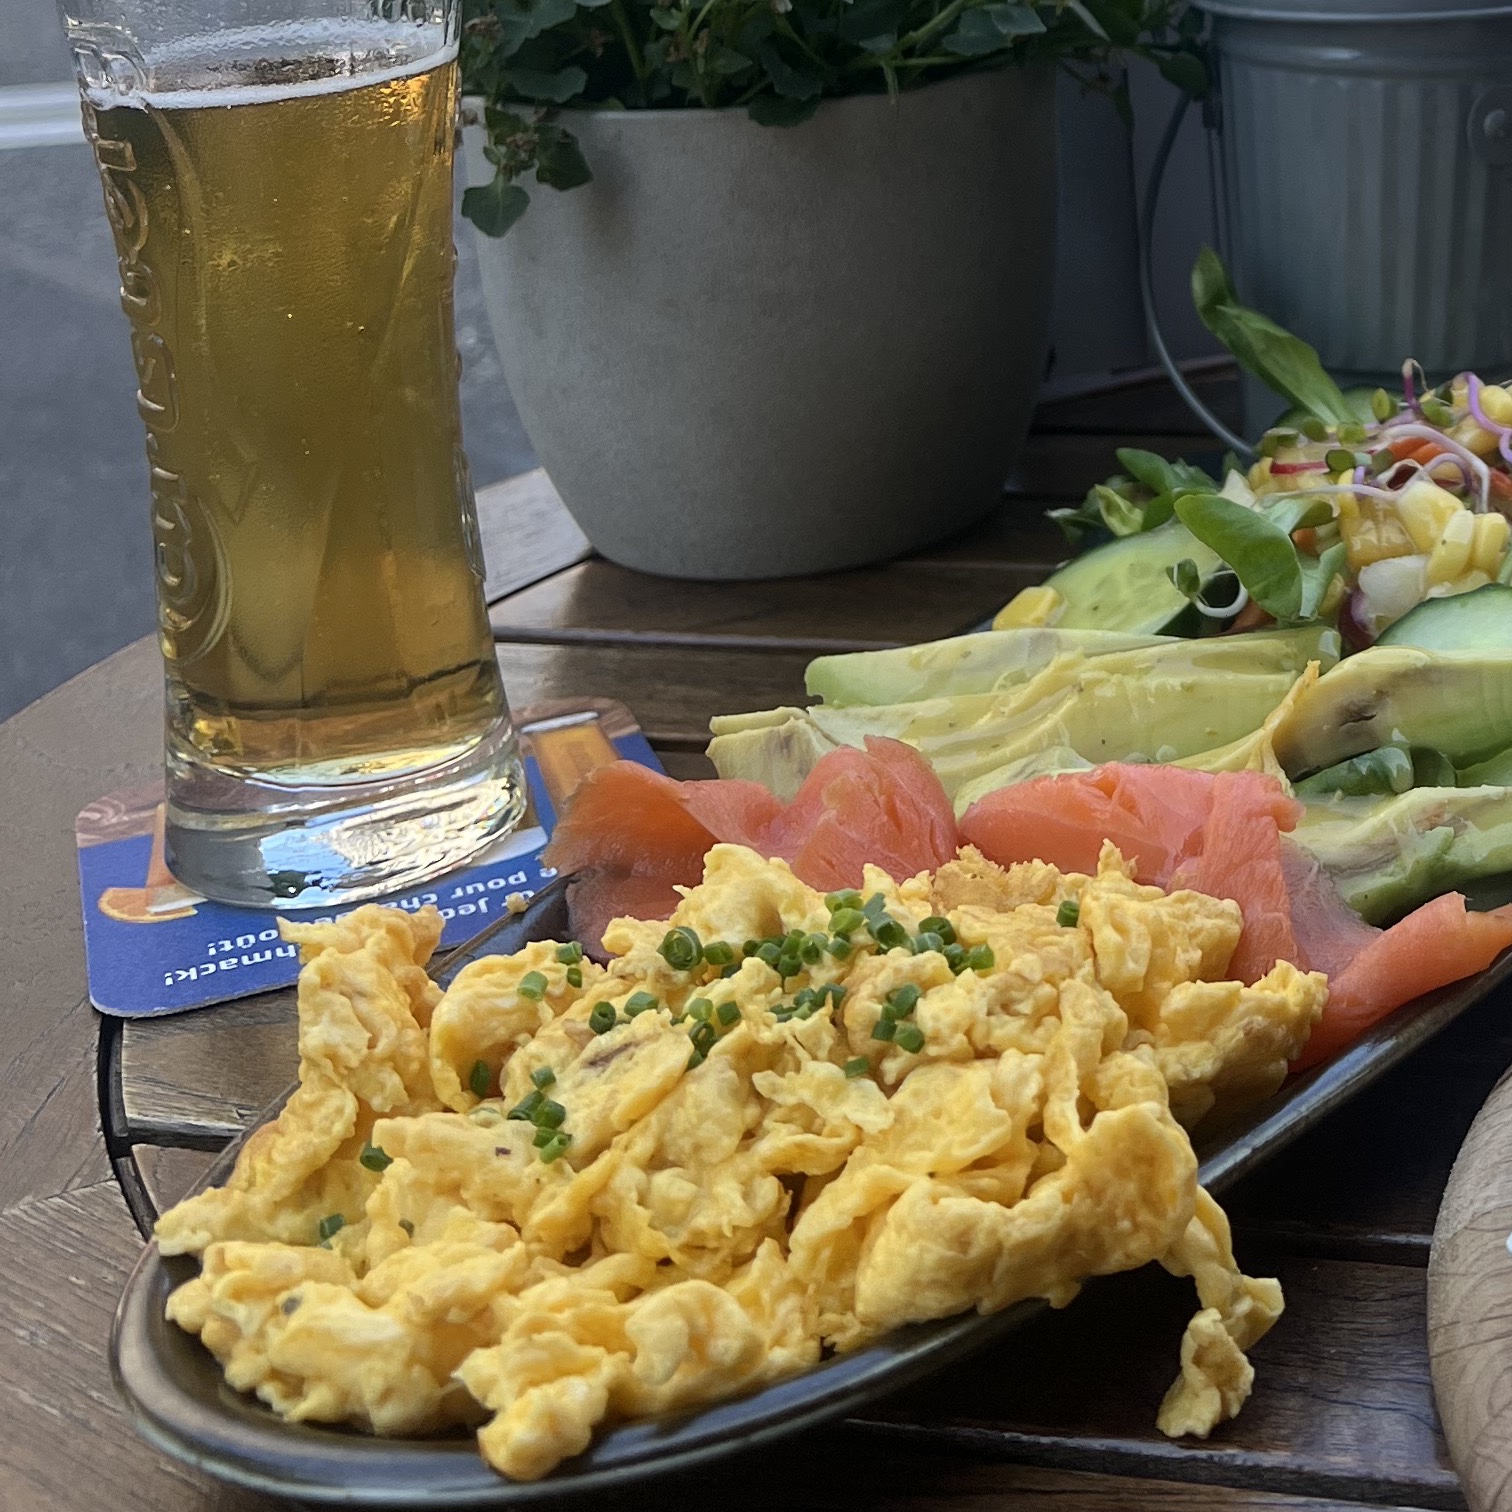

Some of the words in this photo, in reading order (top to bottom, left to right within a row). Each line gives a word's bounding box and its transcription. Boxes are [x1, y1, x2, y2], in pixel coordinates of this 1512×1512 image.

[450, 870, 528, 900] pour
[208, 928, 279, 956] oût!
[164, 944, 297, 987] hmack!
